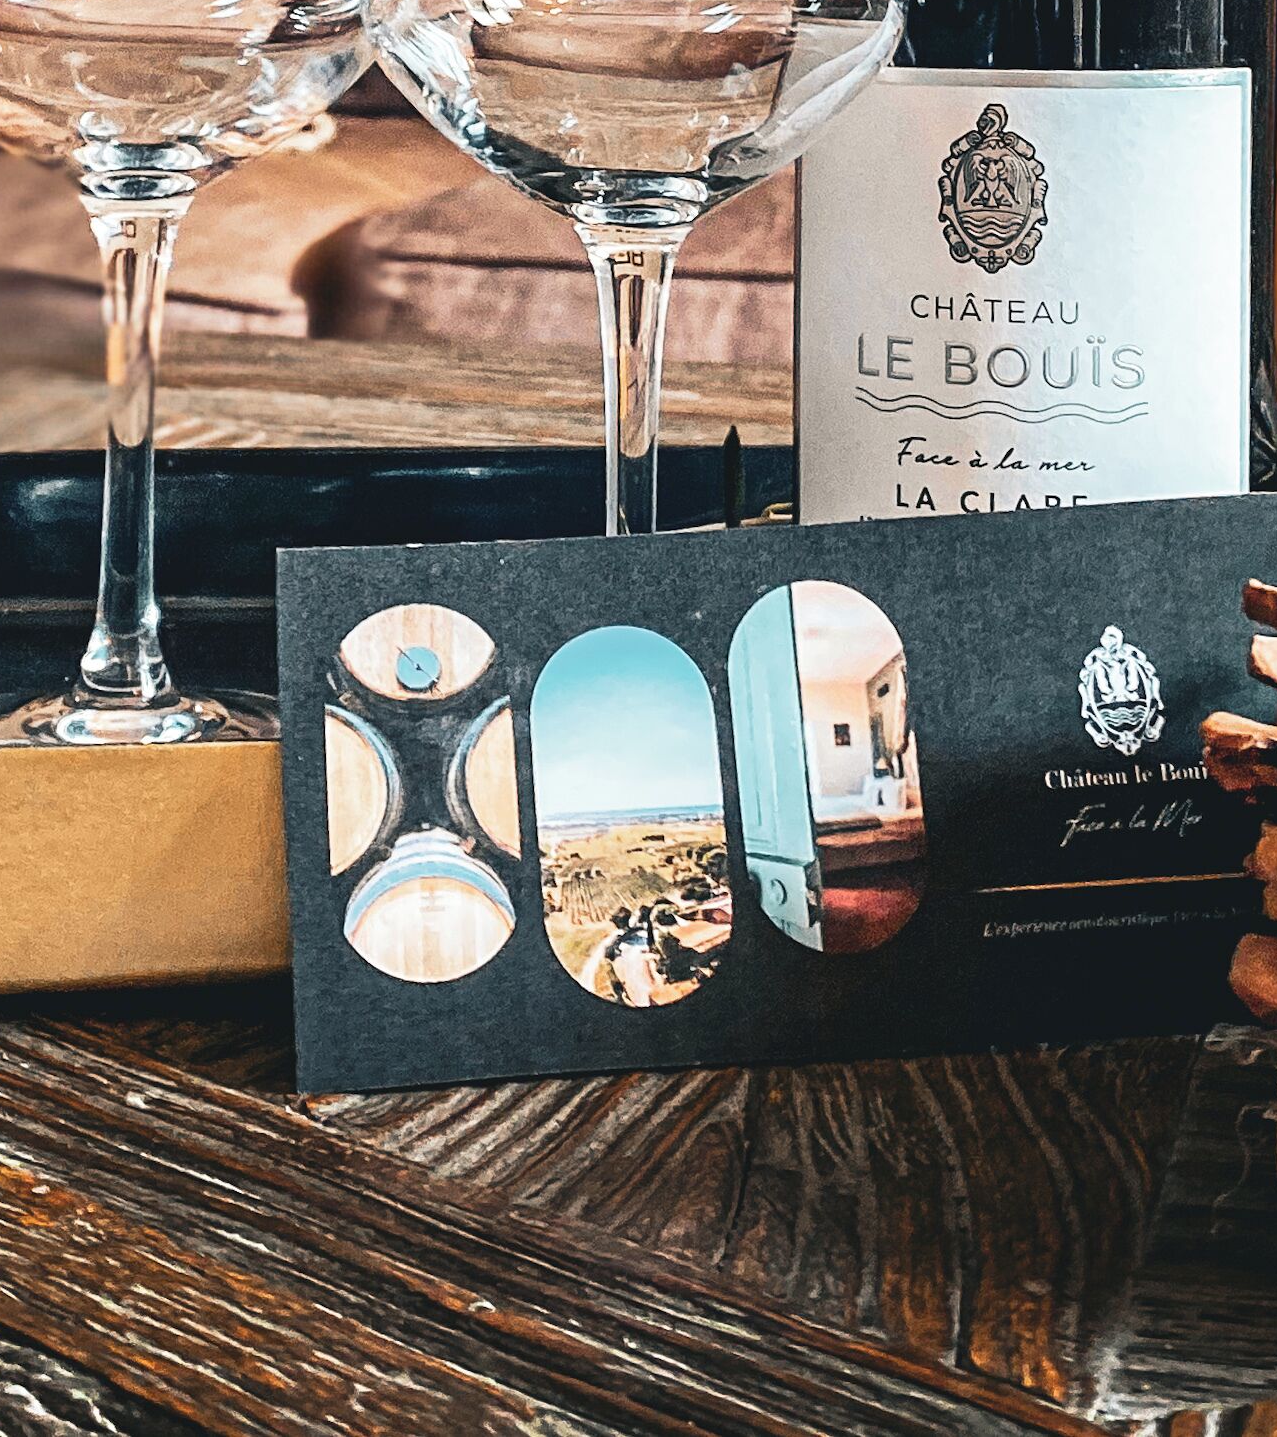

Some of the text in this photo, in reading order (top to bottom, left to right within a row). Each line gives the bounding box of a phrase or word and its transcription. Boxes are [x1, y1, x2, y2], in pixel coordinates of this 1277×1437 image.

[910, 292, 1081, 325] CHÂTEAU
[857, 332, 1147, 390] LE BOUÏS
[897, 436, 1096, 471] Face à la mer
[895, 483, 936, 511] LA
[1134, 764, 1153, 784] le
